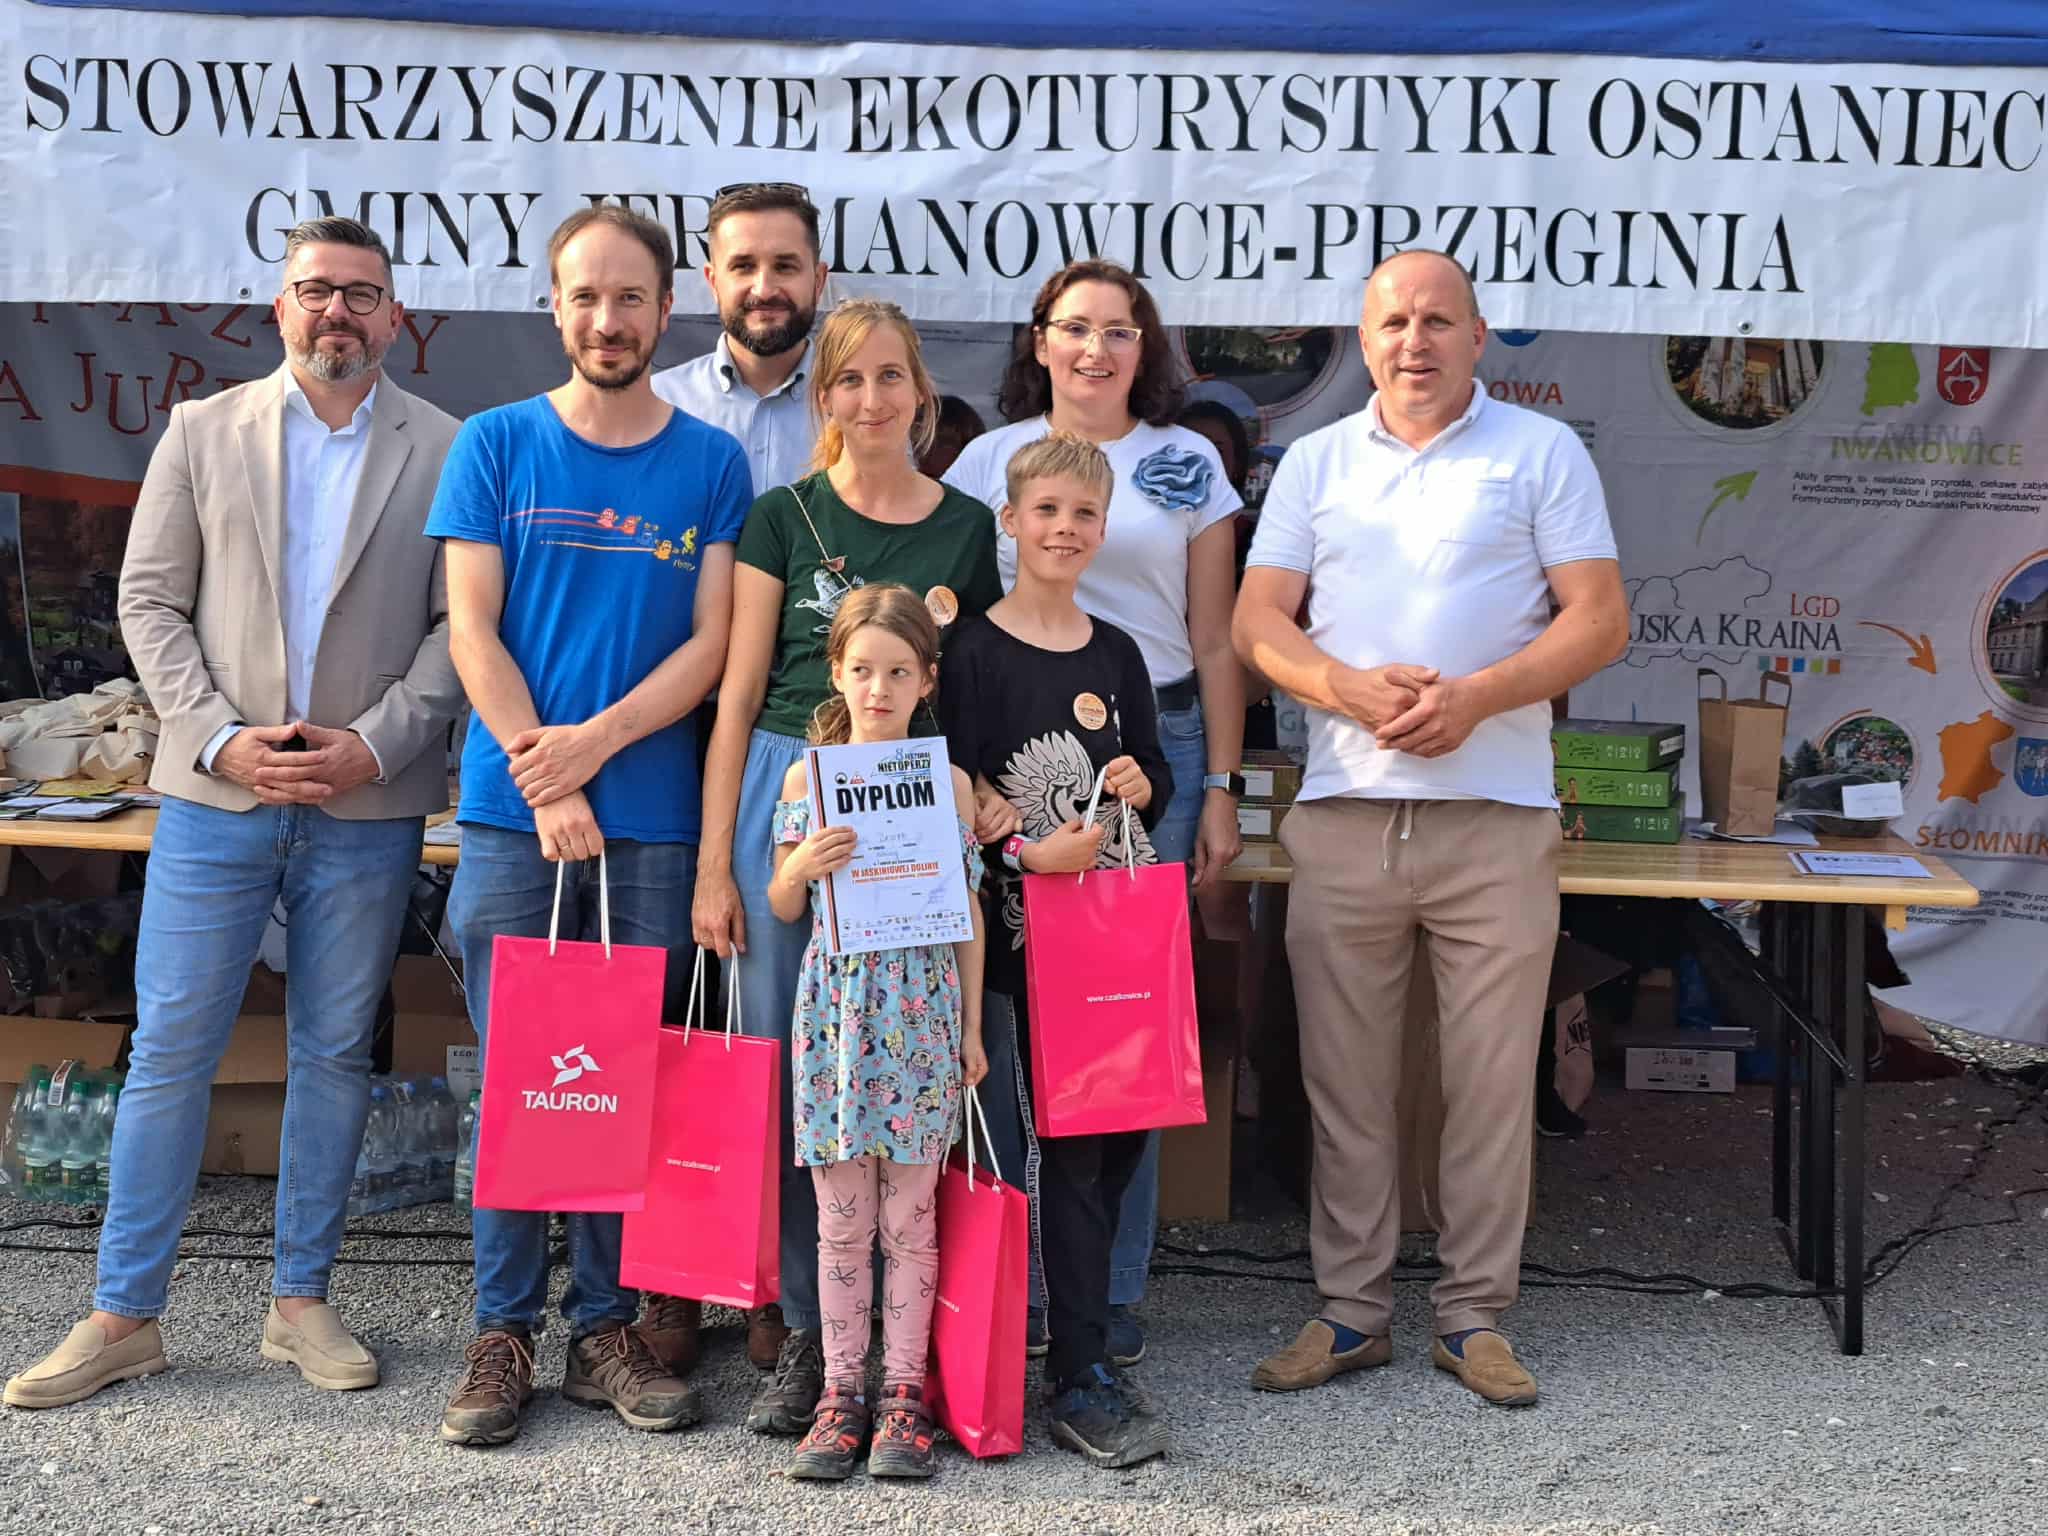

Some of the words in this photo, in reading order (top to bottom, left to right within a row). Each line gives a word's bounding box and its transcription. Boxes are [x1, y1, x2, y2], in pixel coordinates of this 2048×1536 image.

[25, 53, 817, 152] STOWARZYSZENIE
[842, 73, 1561, 156] EKOTURYSTYKI
[1588, 78, 2045, 172] OSTANIEC
[1831, 434, 2025, 467] IWANOWICE
[1790, 593, 1841, 618] LGD
[1629, 613, 1705, 645] JSKA
[1717, 613, 1843, 652] KRAINA
[834, 780, 936, 815] DYPLOM
[521, 1090, 618, 1113] TAURON
